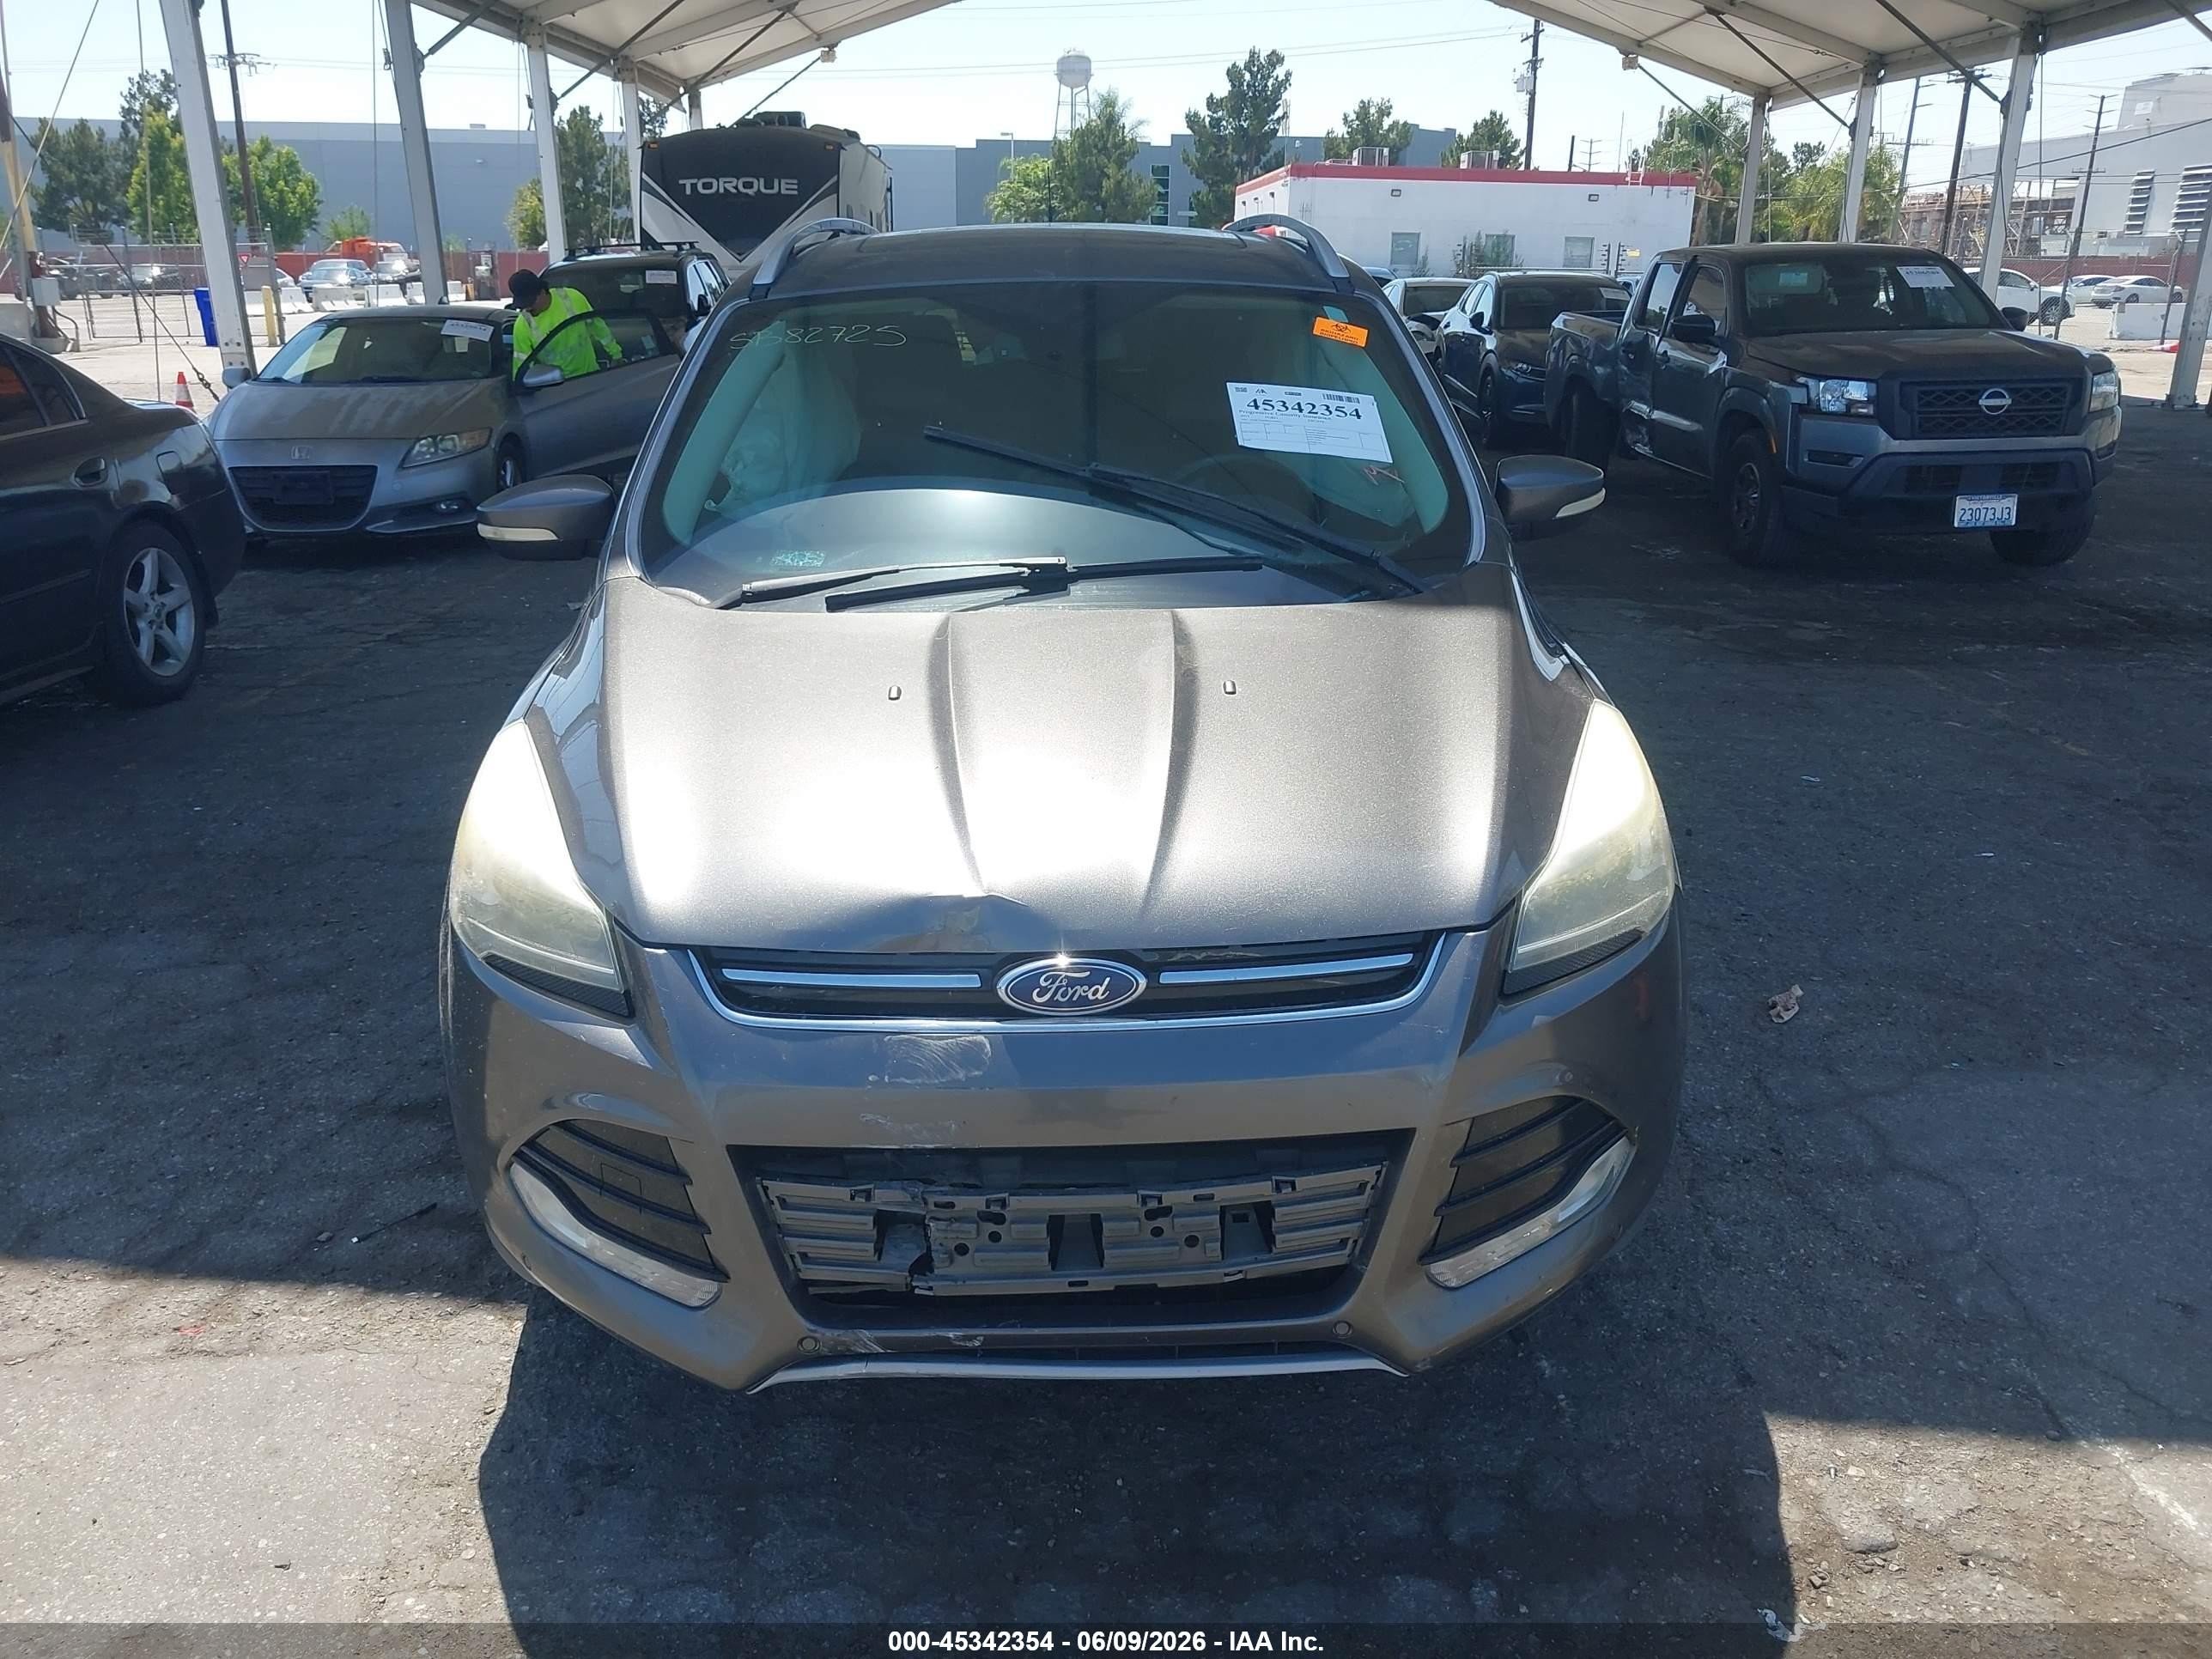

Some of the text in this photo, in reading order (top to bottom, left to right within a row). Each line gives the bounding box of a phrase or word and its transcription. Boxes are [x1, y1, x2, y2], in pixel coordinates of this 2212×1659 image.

[678, 177, 799, 196] TORQUE
[1246, 398, 1363, 420] 45342354
[1959, 507, 2012, 522] 23073J3
[1032, 971, 1110, 1003] Ford
